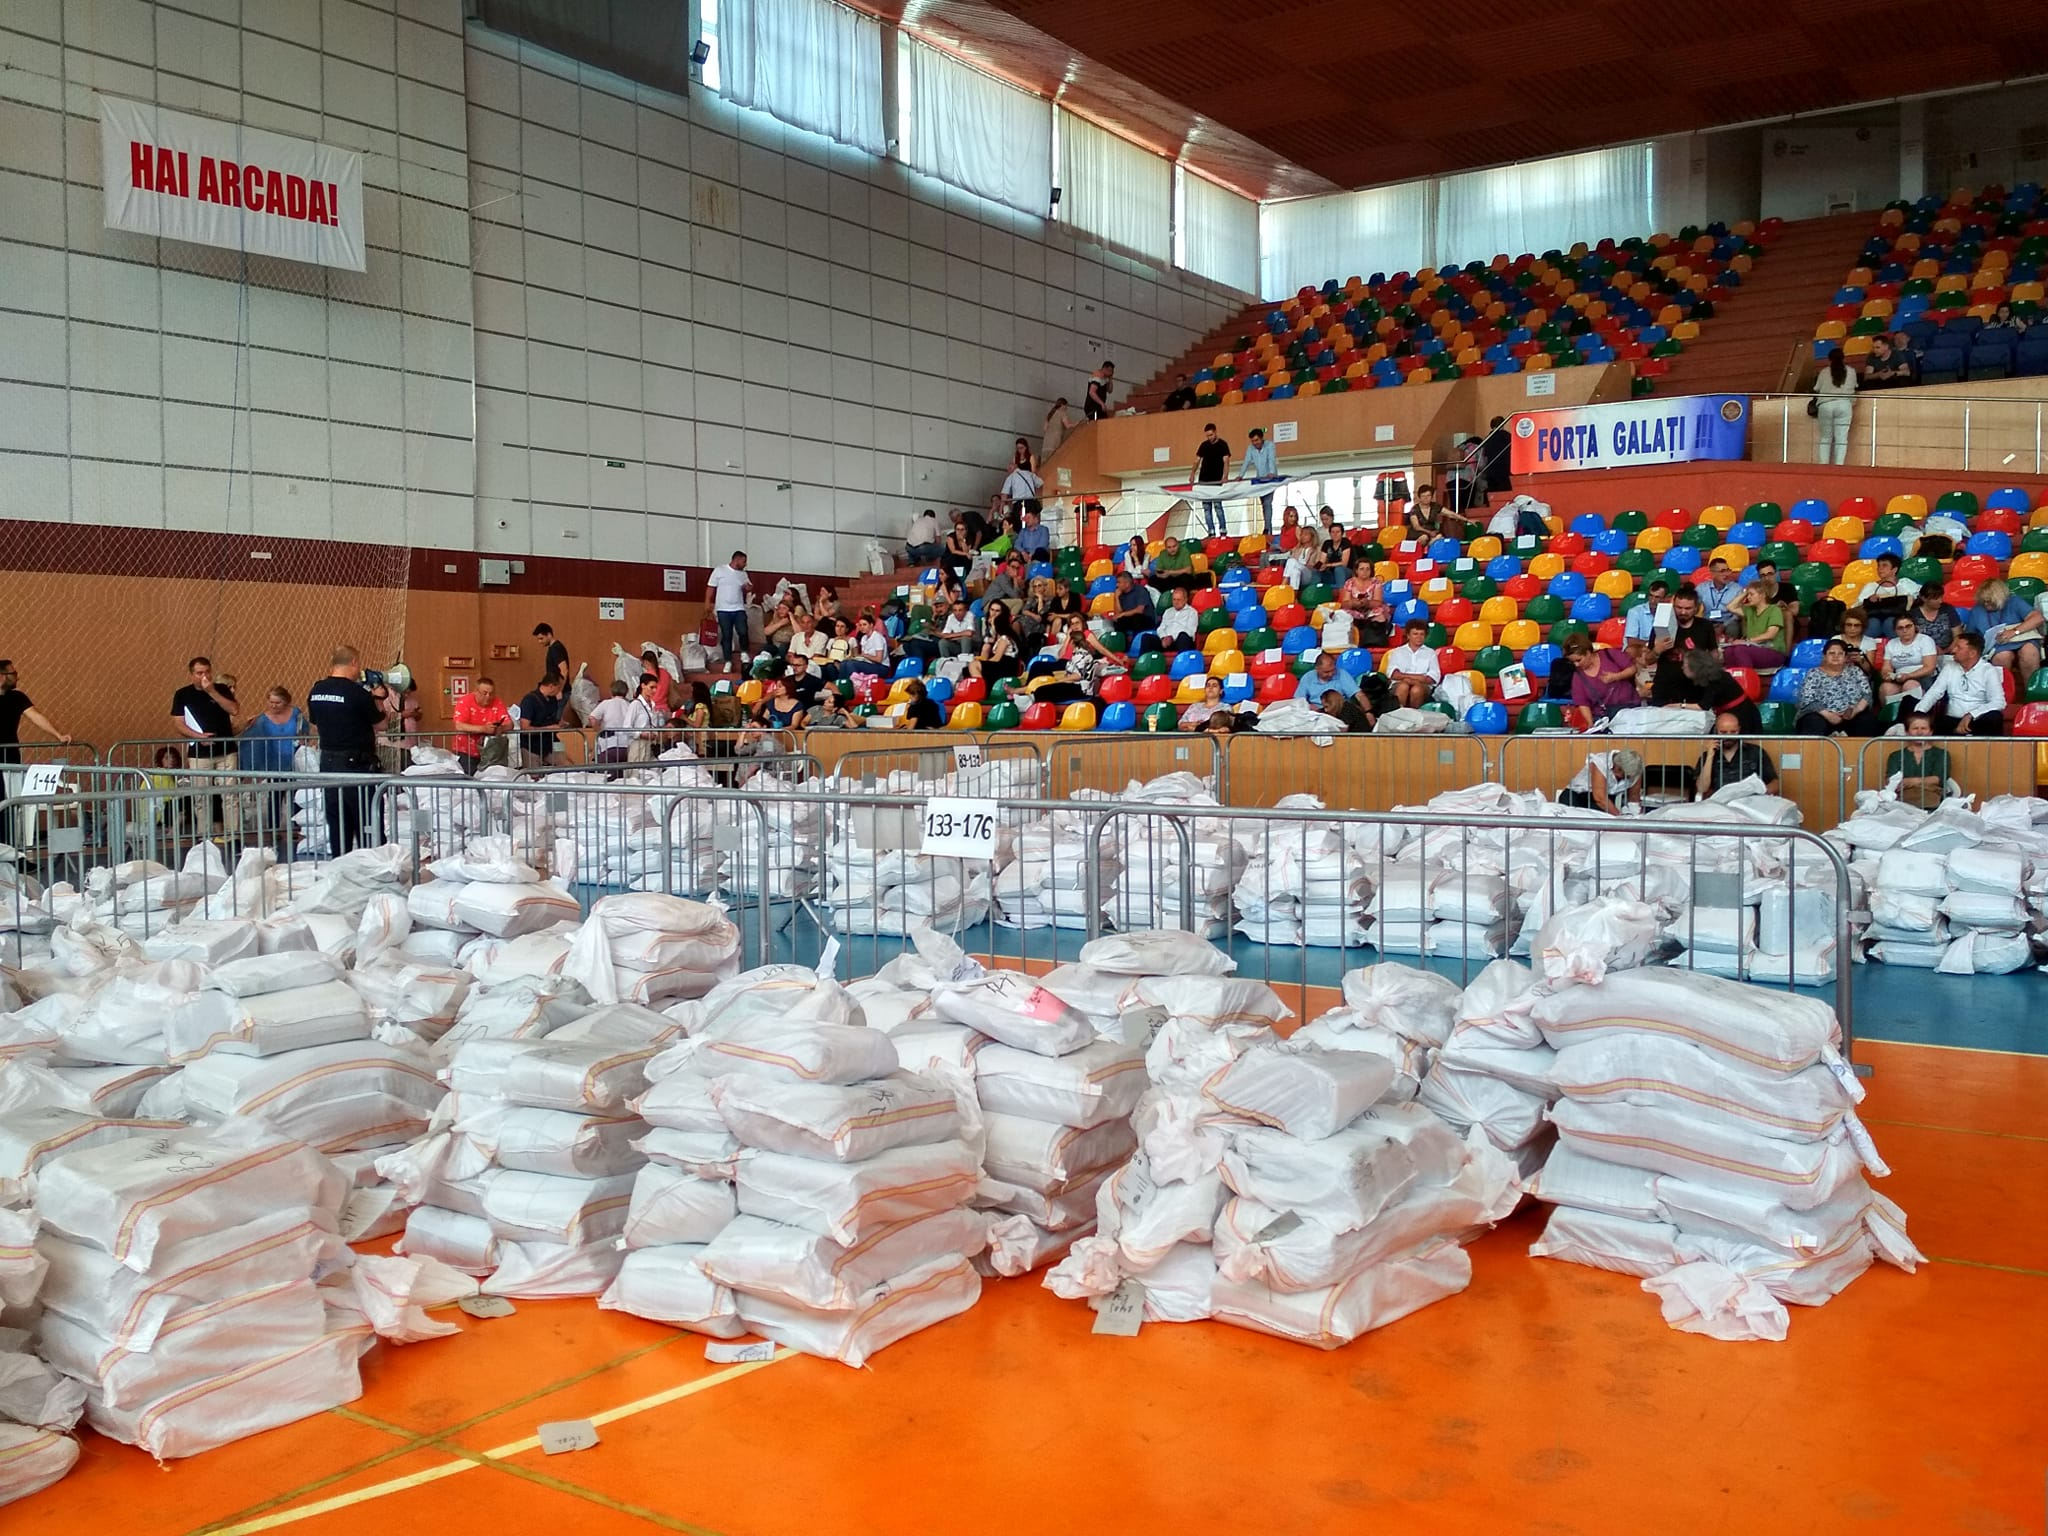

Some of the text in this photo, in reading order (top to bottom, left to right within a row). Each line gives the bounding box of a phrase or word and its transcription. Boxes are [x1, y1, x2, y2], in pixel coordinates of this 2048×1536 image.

[131, 141, 338, 227] HAI ARCADA!
[608, 609, 615, 617] C
[33, 772, 57, 792] 1-44
[926, 813, 994, 840] 133-176
